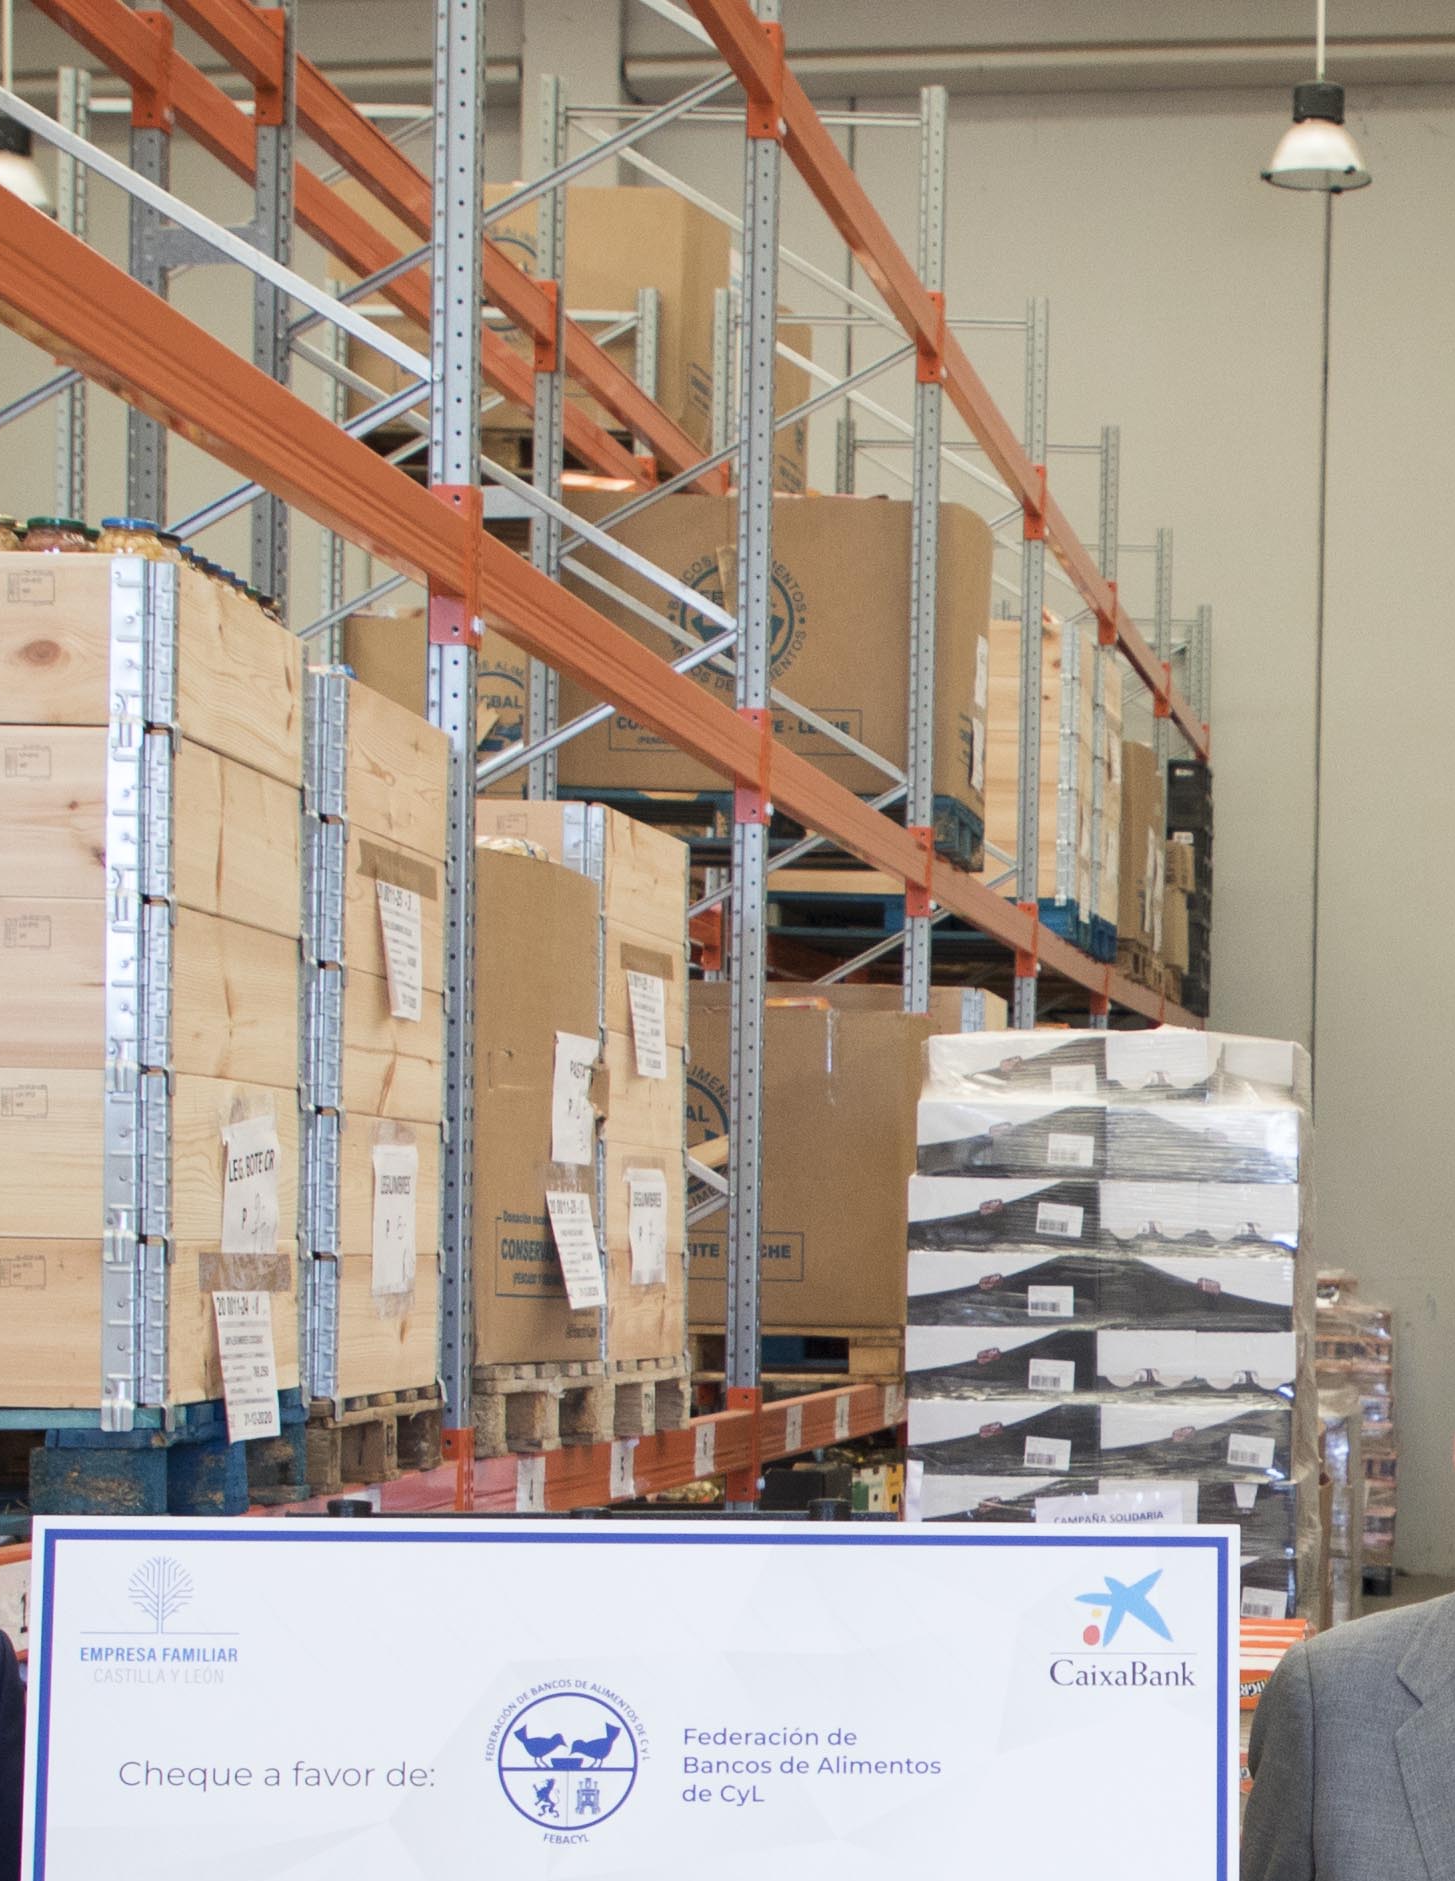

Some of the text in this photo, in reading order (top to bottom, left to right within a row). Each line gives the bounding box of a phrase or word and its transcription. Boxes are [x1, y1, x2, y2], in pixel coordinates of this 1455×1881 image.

[1110, 1510, 1165, 1523] SOLIDARIA
[79, 1646, 239, 1664] EMPRESA FAMILIAR
[93, 1664, 224, 1685] CASTILLA Y LEÓN
[1048, 1659, 1196, 1689] CaixaBank
[485, 1679, 647, 1762] FEDERACIÓN DE BANCOS DE ALIMENTOS DE
[682, 1726, 858, 1747] Federación de
[682, 1754, 942, 1776] Bancos de Alimentos
[118, 1759, 437, 1793] Cheque a favor de:
[682, 1784, 765, 1808] de CyL
[543, 1832, 591, 1846] FEBACYL
